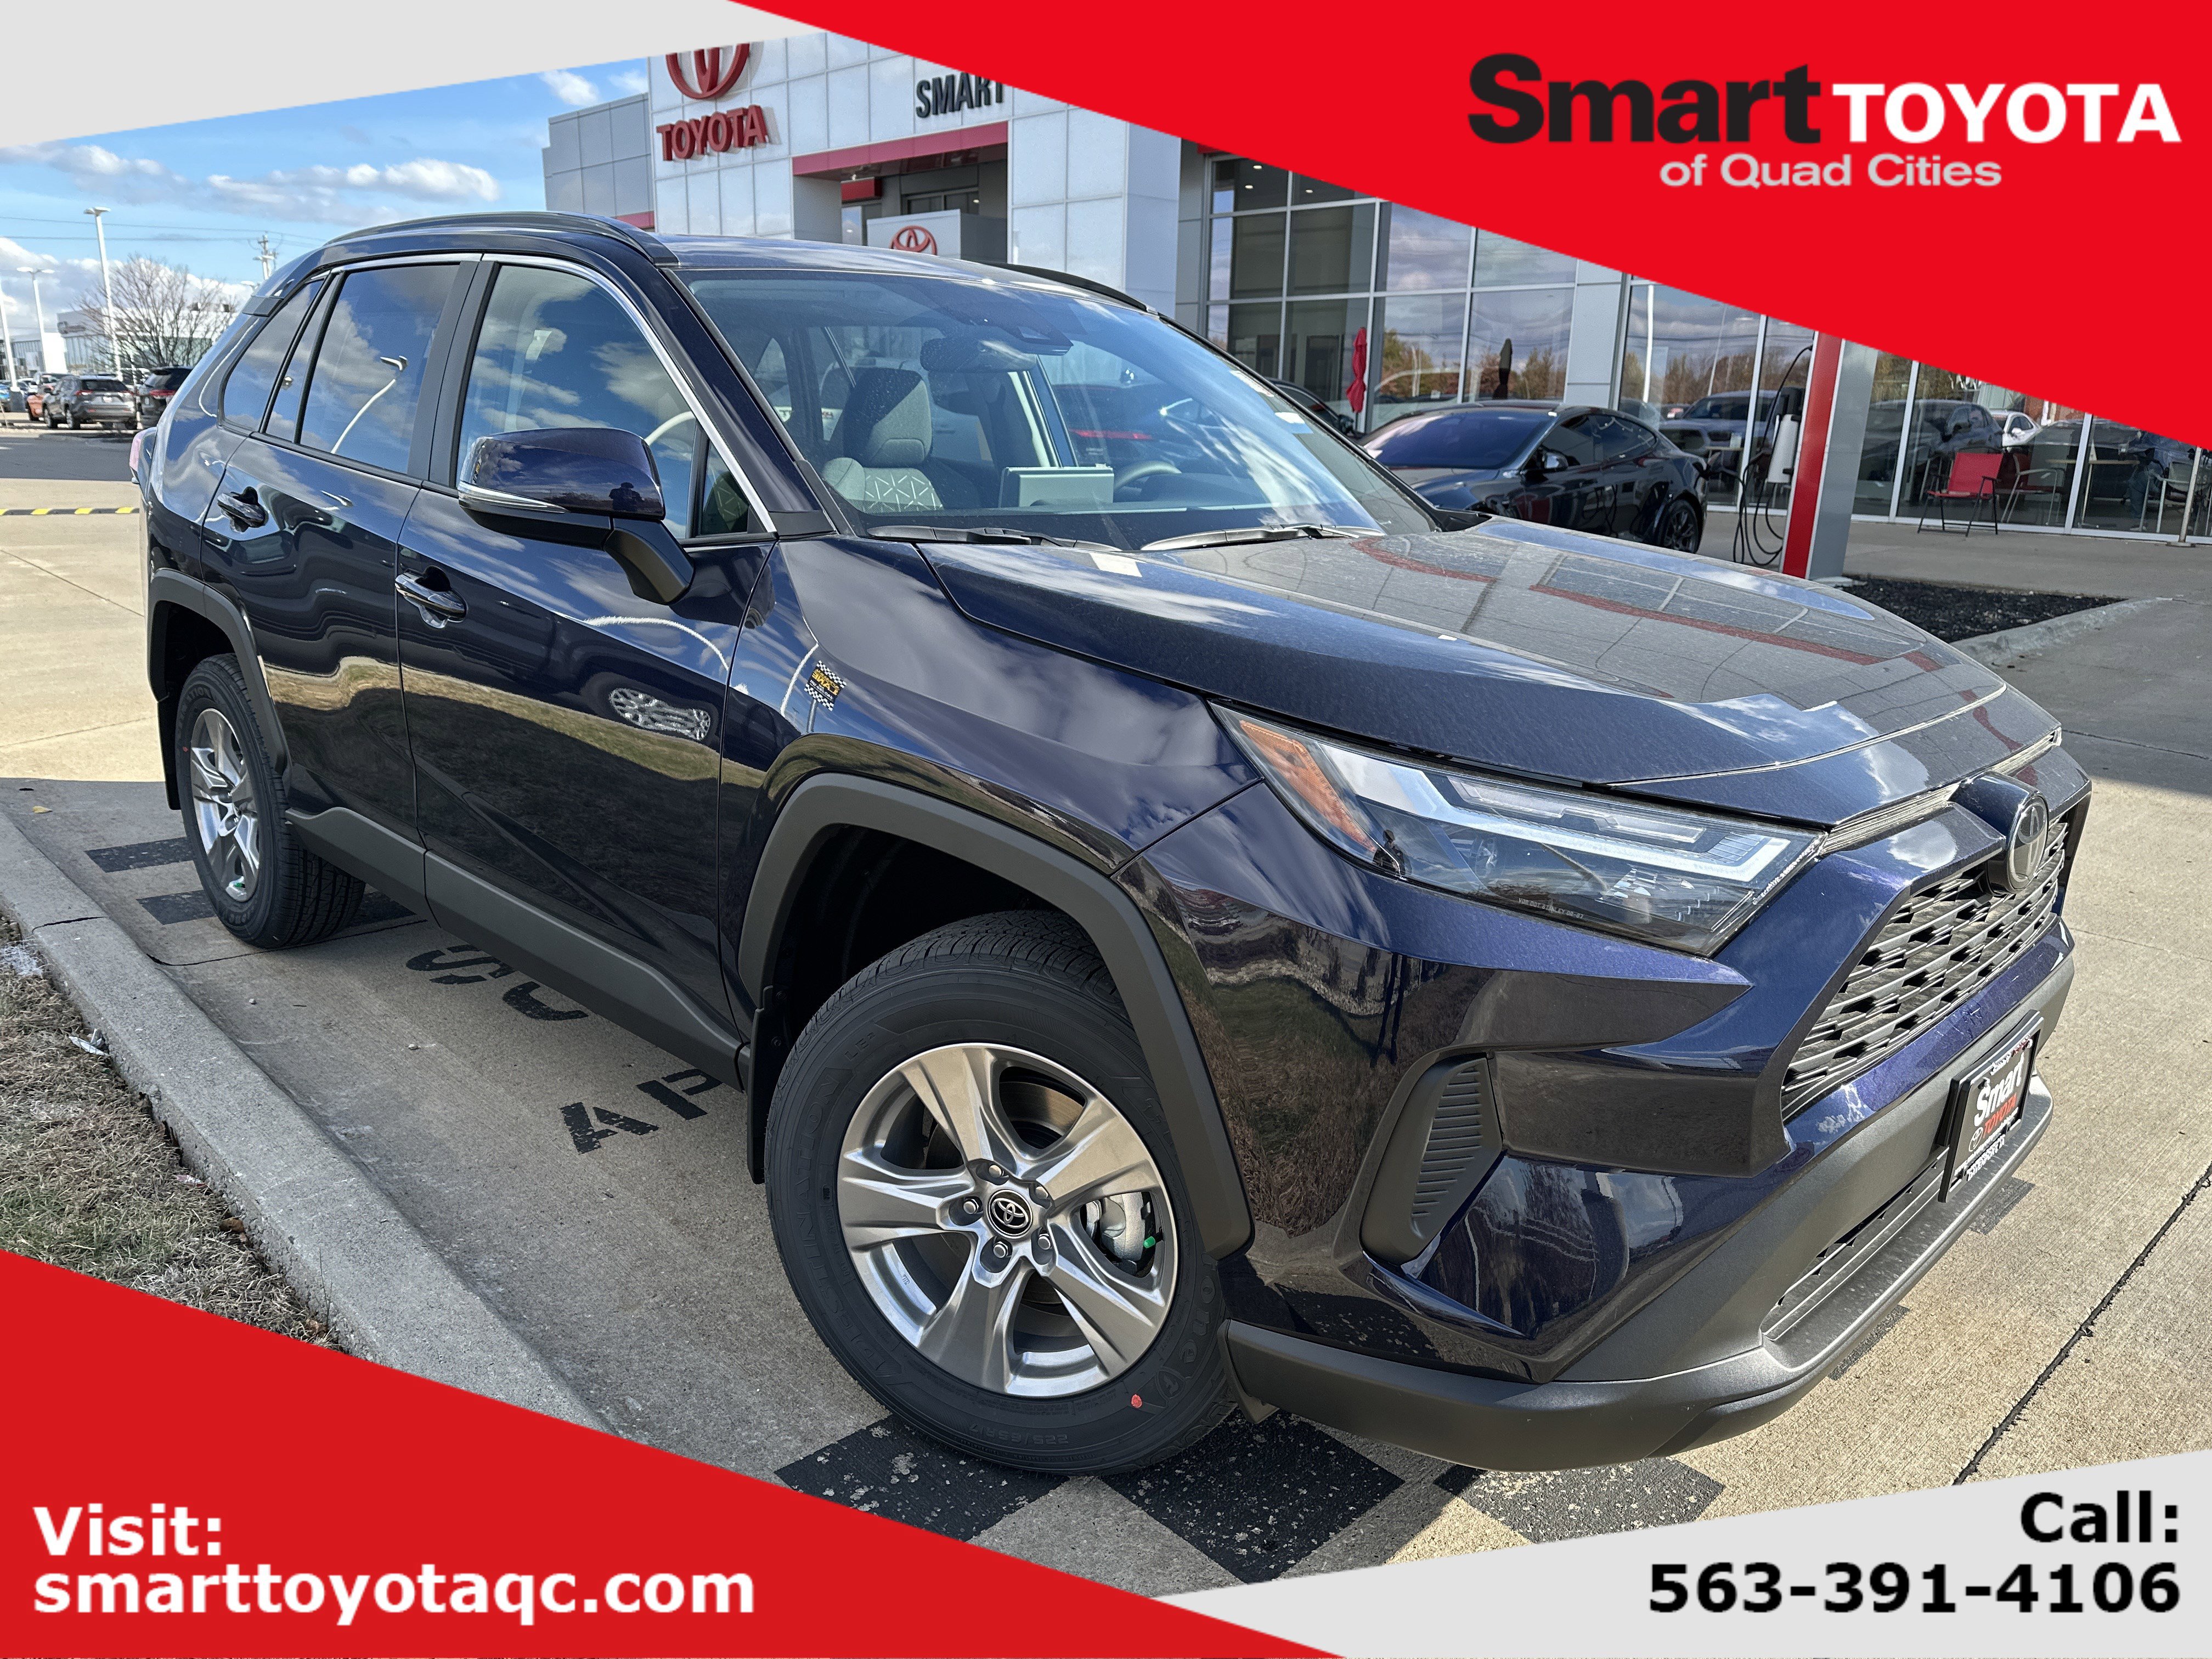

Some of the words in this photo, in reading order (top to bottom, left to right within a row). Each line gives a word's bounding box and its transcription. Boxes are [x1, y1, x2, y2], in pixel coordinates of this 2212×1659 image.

[656, 104, 768, 161] TOYOTA
[559, 1068, 724, 1155] AP
[1974, 1052, 2024, 1127] Smart
[1983, 1092, 2017, 1139] TOYOTA
